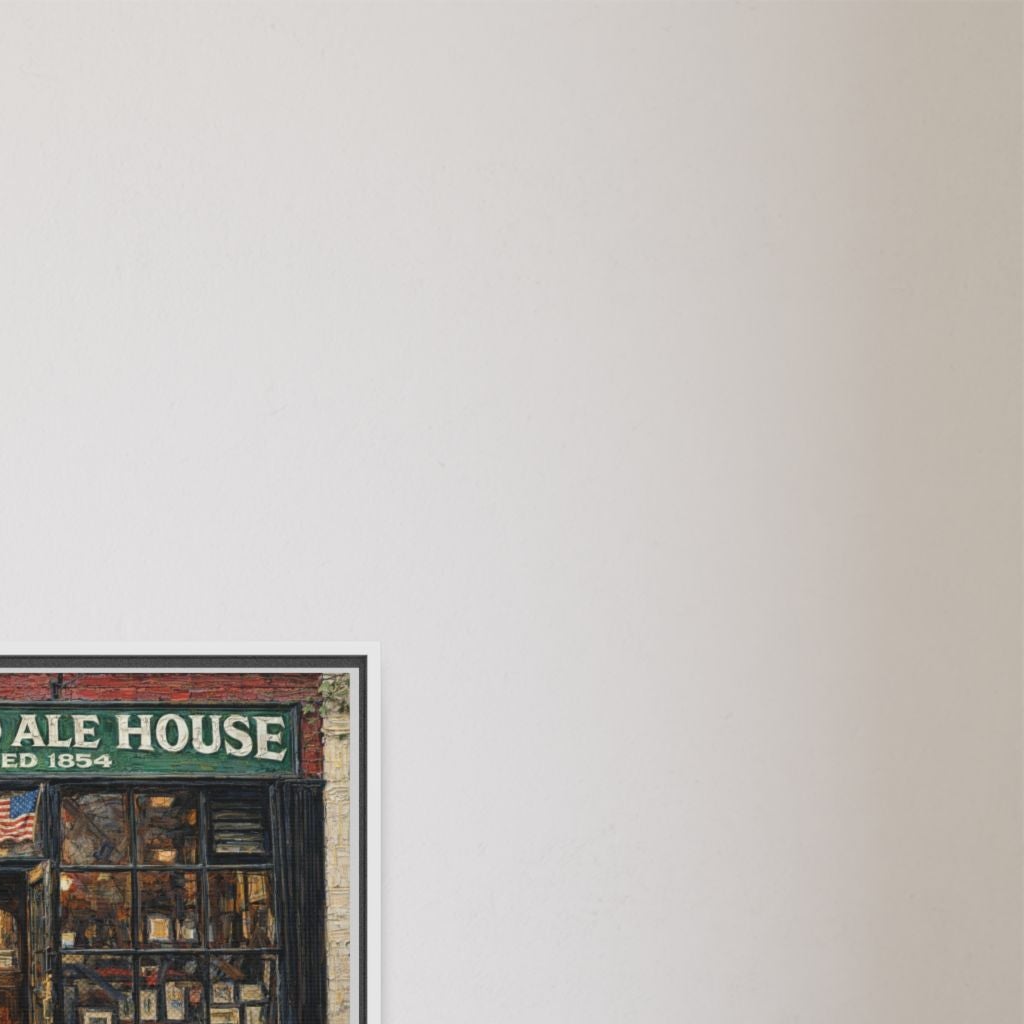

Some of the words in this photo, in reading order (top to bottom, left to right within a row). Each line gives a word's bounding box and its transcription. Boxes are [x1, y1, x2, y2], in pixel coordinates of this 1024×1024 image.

[11, 713, 101, 750] ALE
[115, 713, 288, 762] HOUSE
[47, 752, 113, 769] 1854
